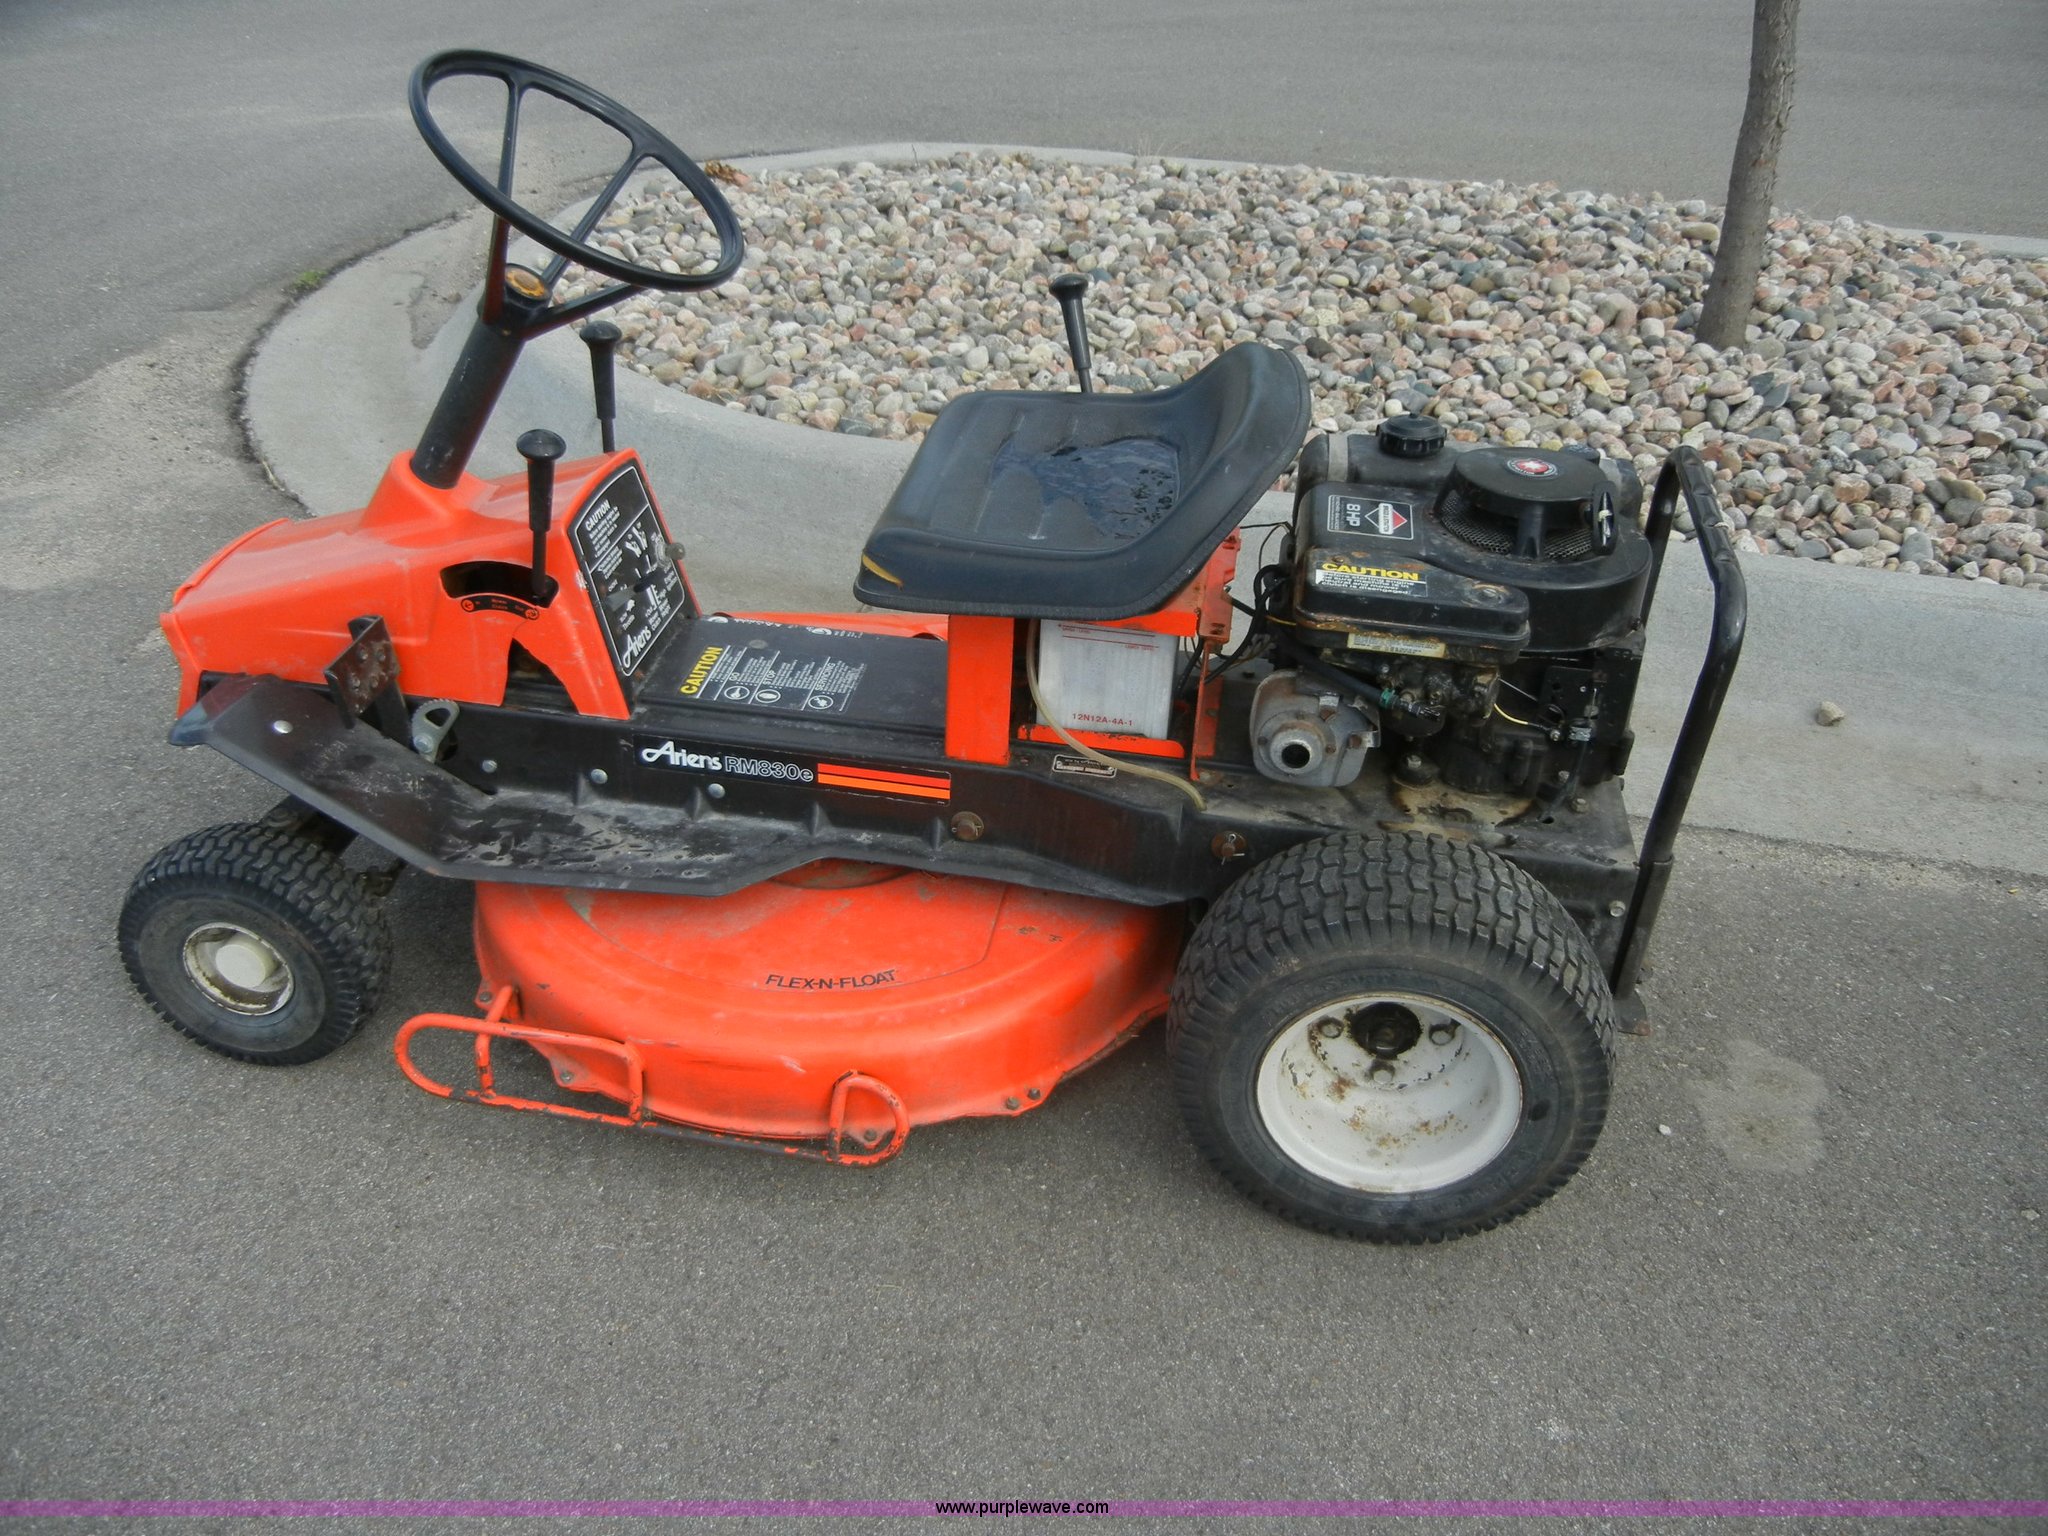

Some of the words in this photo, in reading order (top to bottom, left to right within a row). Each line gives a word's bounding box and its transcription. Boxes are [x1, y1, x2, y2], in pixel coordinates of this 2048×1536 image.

[585, 499, 610, 531] CAUTION
[1322, 563, 1419, 580] CAUTION
[622, 627, 652, 668] Ariens
[680, 647, 723, 694] CAUTION
[729, 672, 740, 682] GO
[762, 669, 777, 685] STOP
[814, 662, 836, 691] SERVICING
[1072, 712, 1134, 727] 12N12A-4A-1
[642, 741, 723, 770] Ariens
[724, 756, 814, 783] RM830e
[765, 969, 896, 989] FLEX-N-FLOAT
